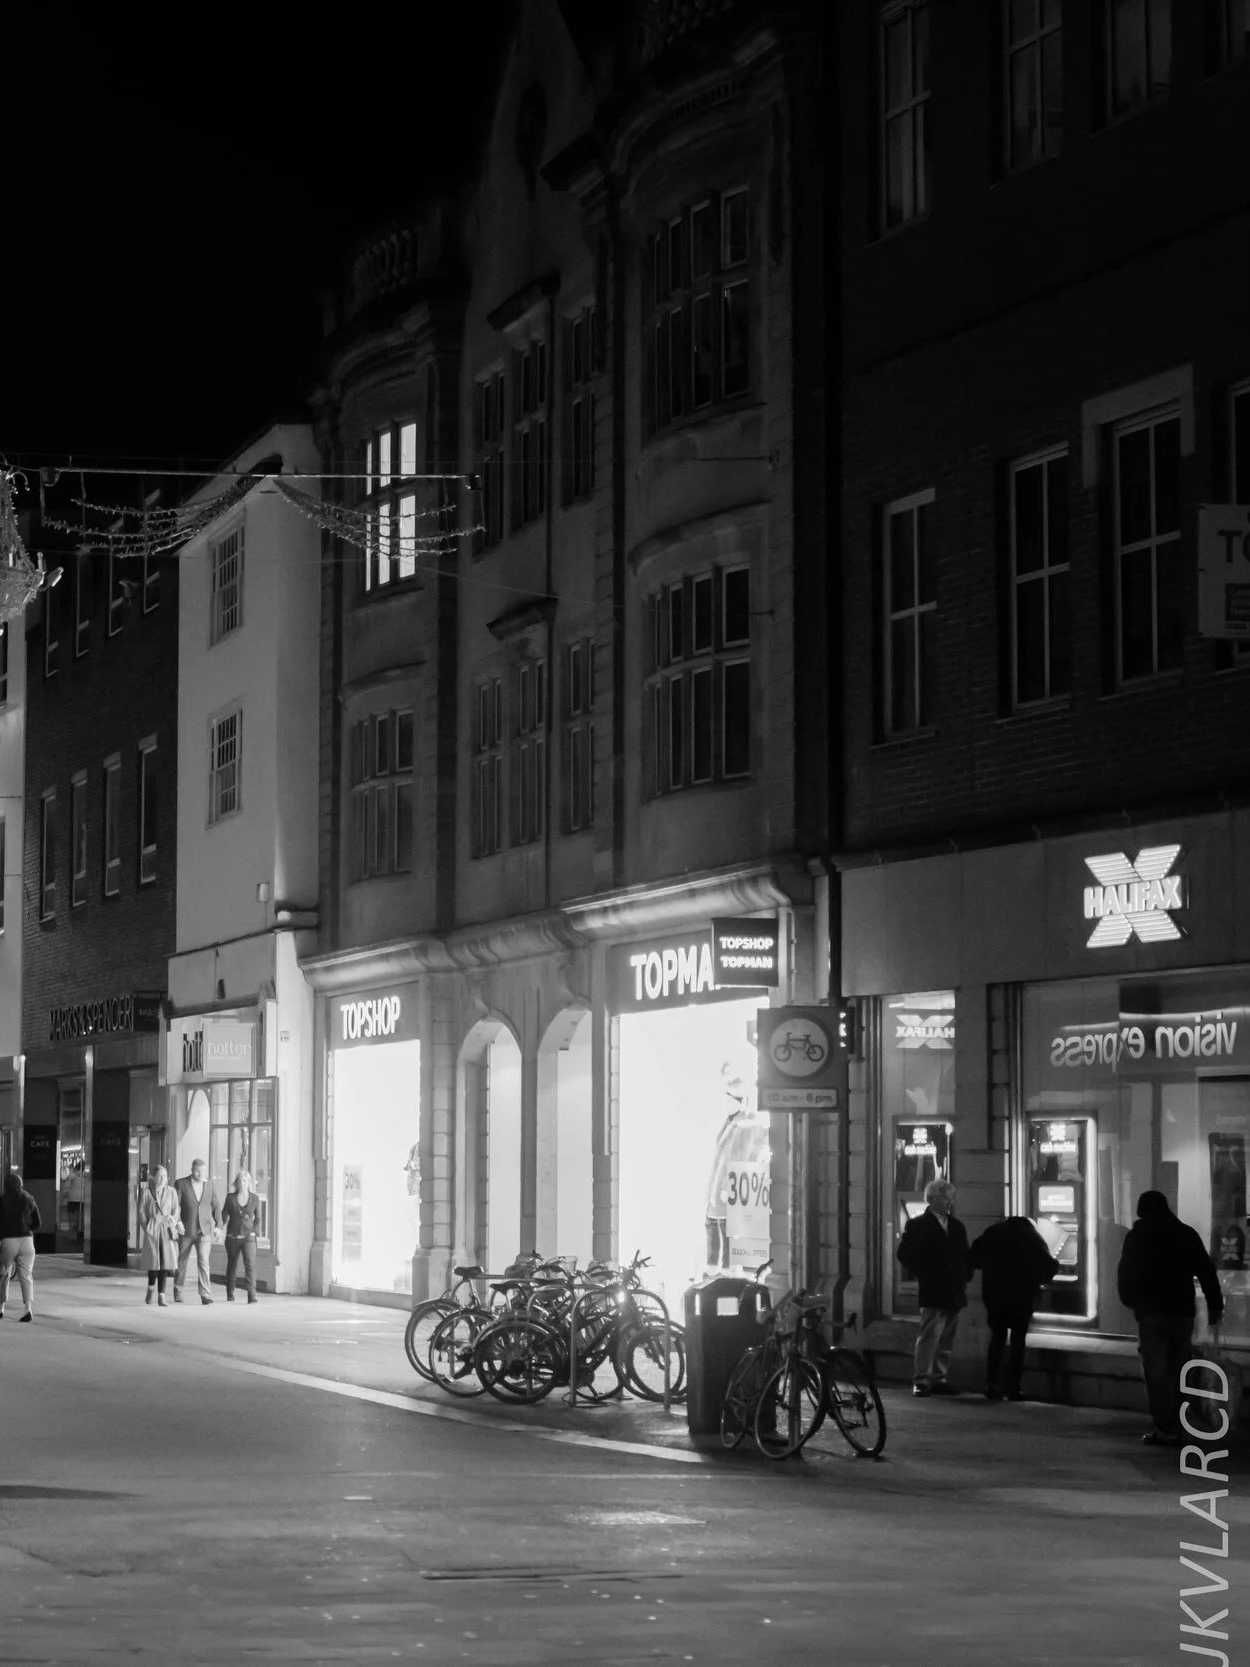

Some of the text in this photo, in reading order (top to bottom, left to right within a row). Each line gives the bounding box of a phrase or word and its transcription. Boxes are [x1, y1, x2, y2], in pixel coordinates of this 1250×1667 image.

[1084, 874, 1182, 919] HALIFAX
[719, 936, 774, 950] TOPSHOP
[720, 956, 773, 969] TOPMAN
[630, 942, 723, 1001] TOPMA
[340, 995, 401, 1040] TOPSHOP
[182, 1031, 203, 1073] hott
[806, 1092, 813, 1103] 6
[815, 1095, 834, 1105] pm
[726, 1171, 770, 1208] 30%
